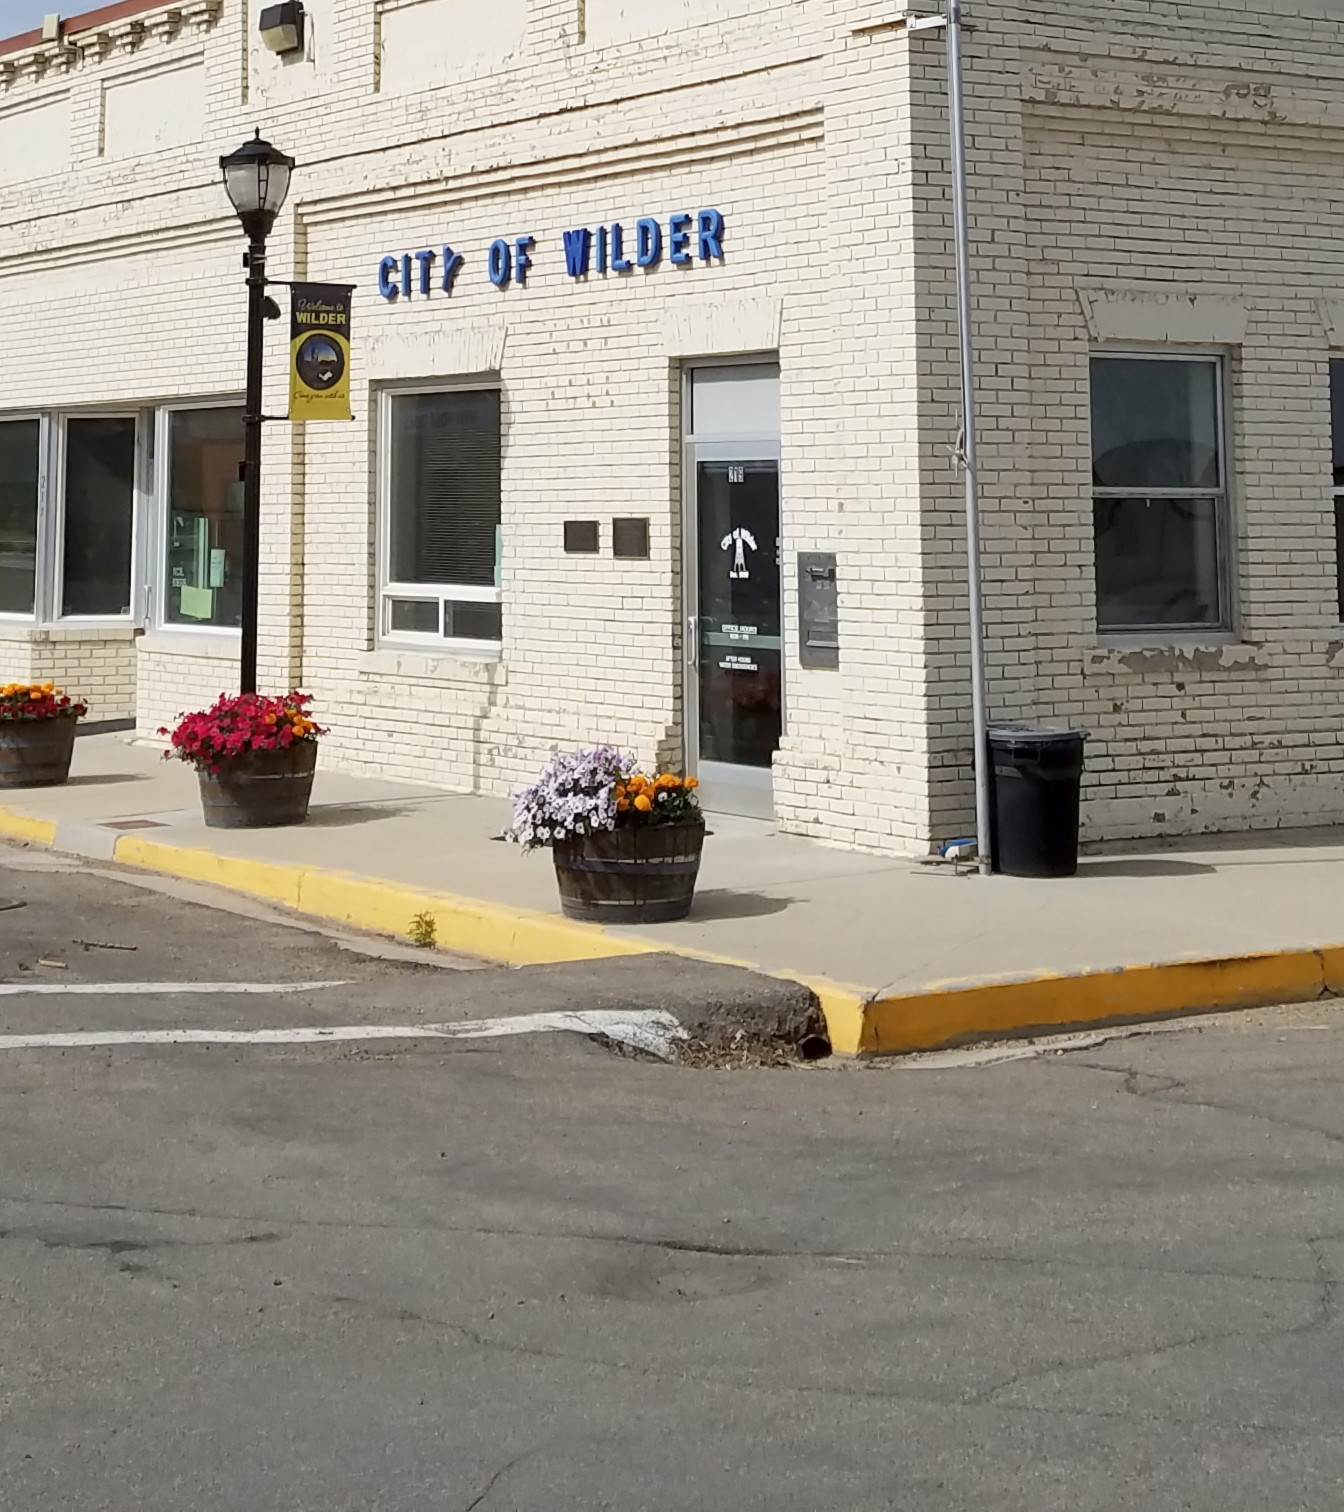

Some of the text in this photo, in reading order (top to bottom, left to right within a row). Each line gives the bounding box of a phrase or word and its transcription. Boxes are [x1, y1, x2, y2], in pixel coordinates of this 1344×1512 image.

[378, 208, 725, 299] CITY OF WILDER
[295, 311, 346, 325] WILDER
